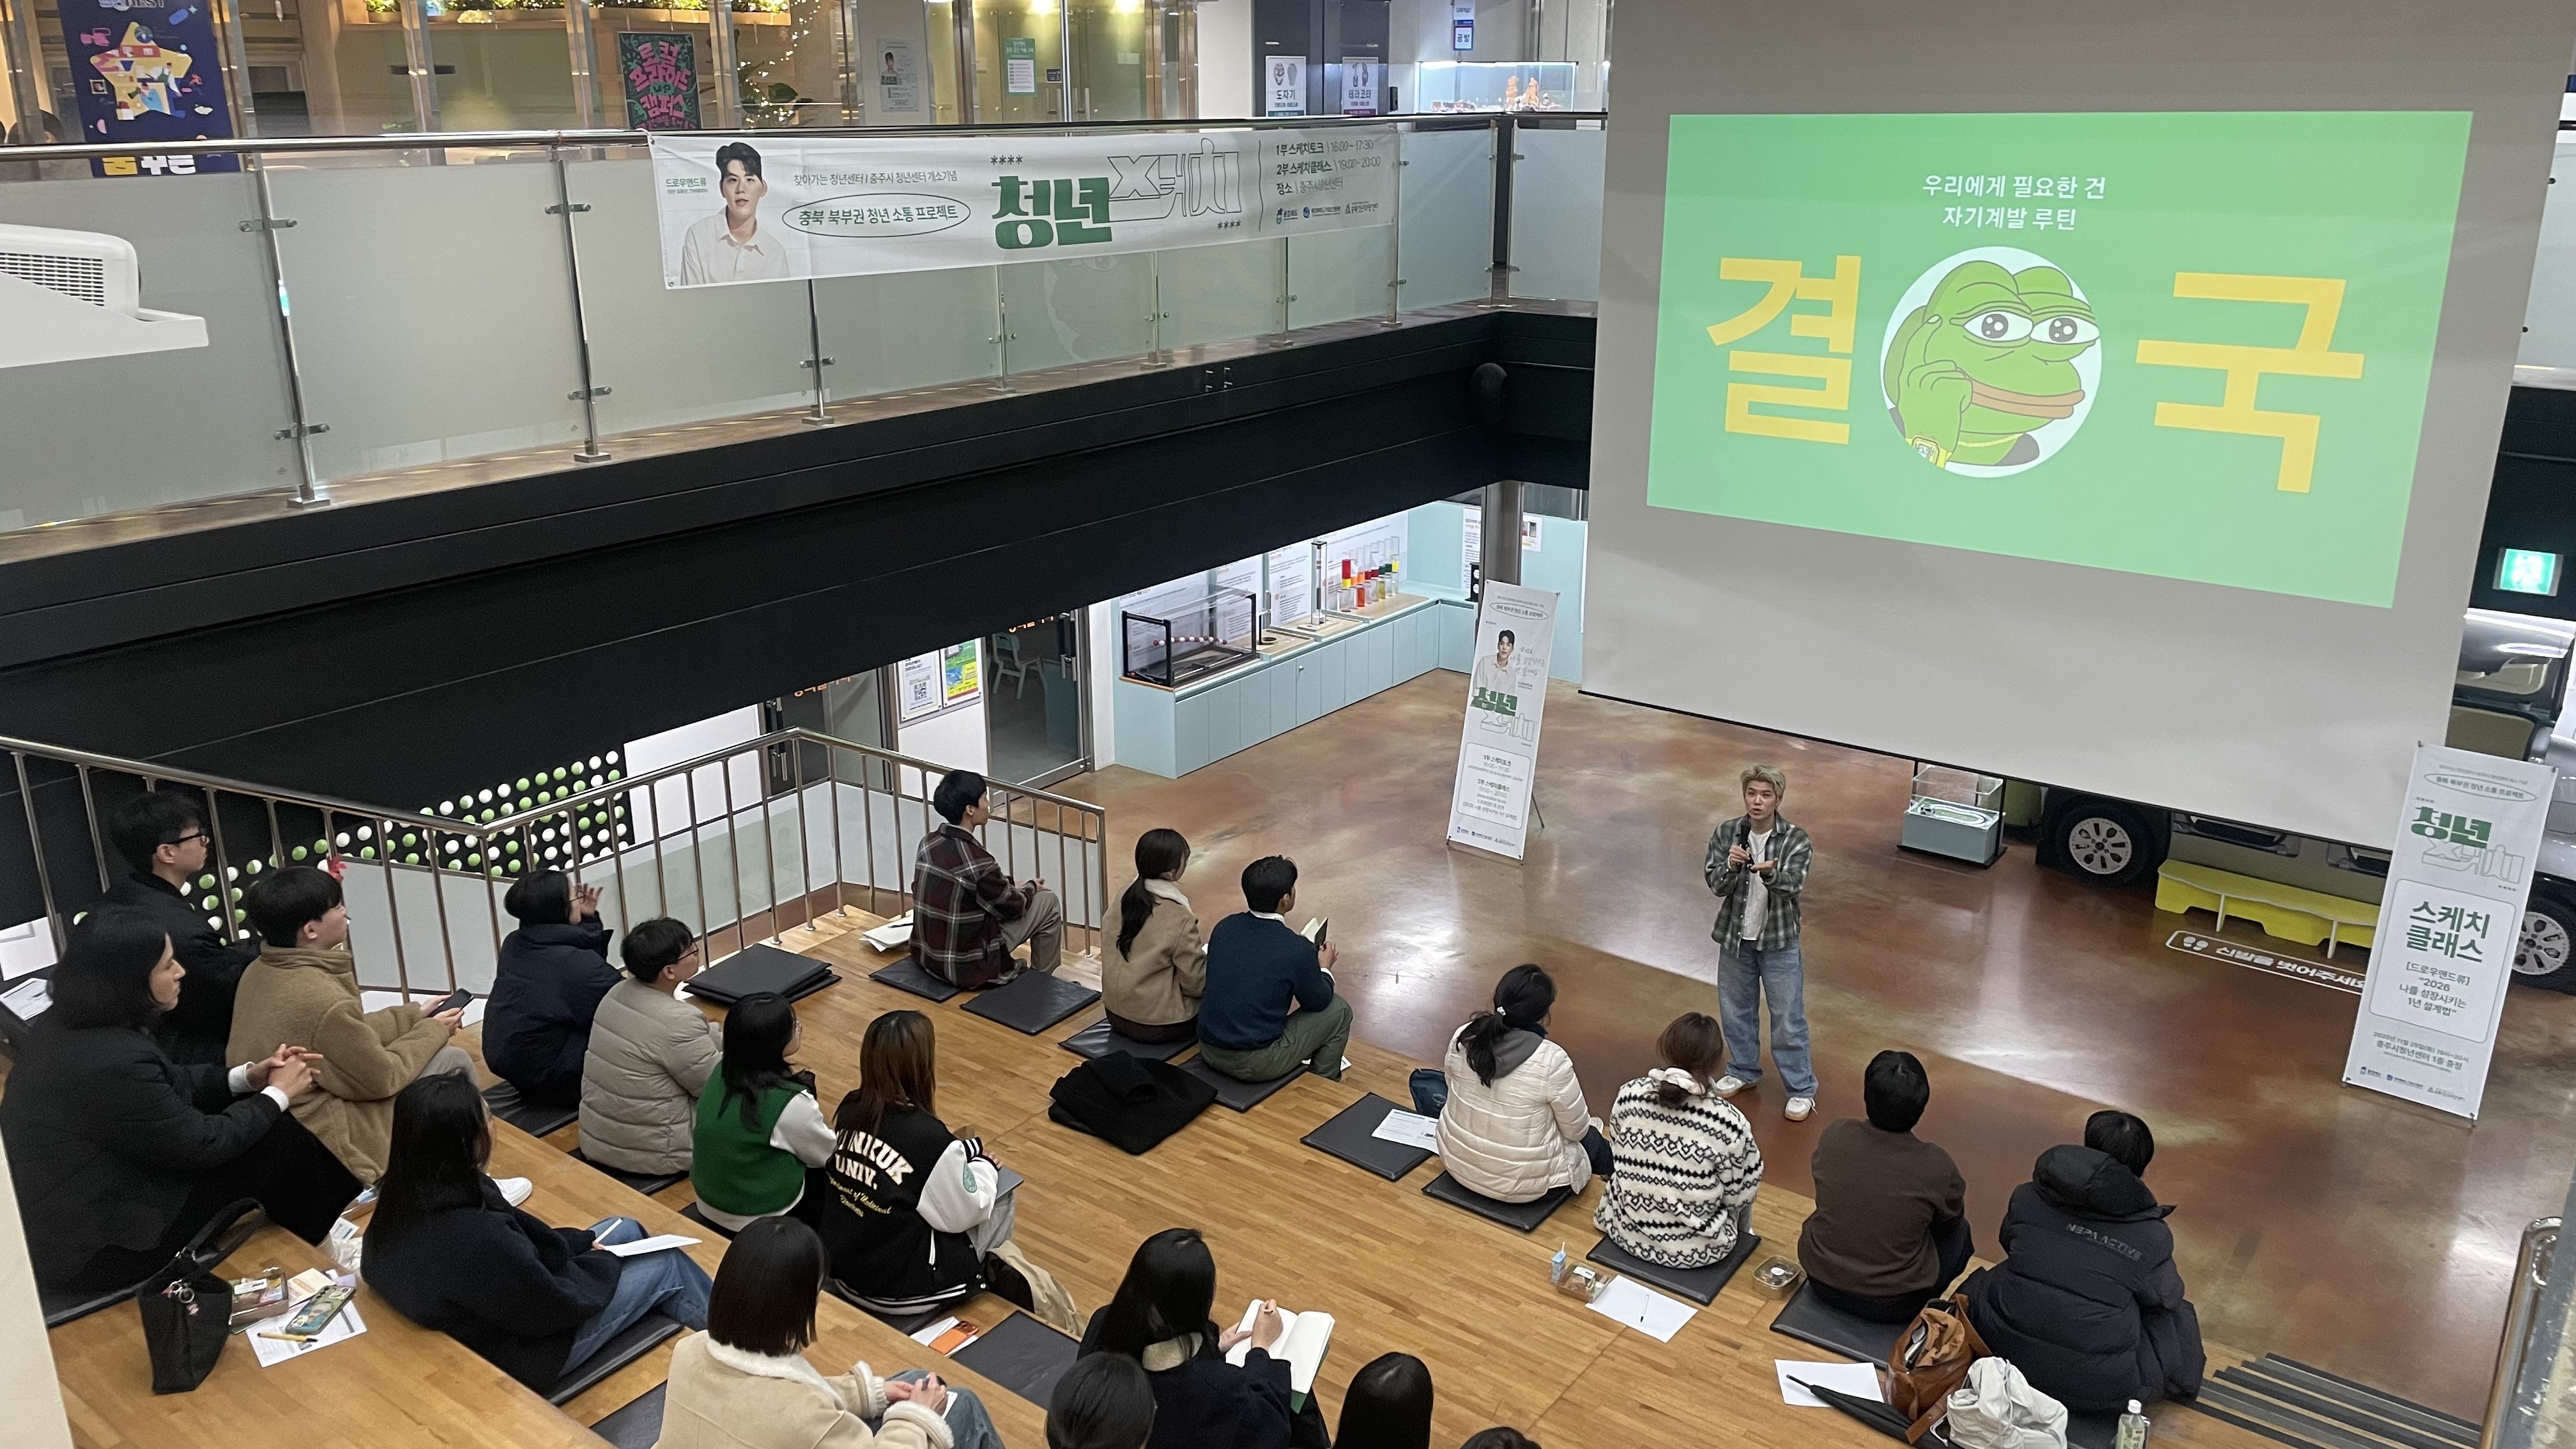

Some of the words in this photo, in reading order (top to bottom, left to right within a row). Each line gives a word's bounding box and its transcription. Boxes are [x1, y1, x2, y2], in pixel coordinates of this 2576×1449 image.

[1457, 34, 1470, 42] 공방
[640, 94, 685, 118] 캠퍼스
[1276, 89, 1296, 100] 도자기
[1348, 89, 1372, 99] 테라코타
[666, 177, 707, 187] 드로우앤드류
[793, 174, 828, 187] 찾아가는
[829, 172, 863, 185] 청년센터
[869, 172, 894, 184] 충주시
[895, 171, 926, 183] 청년센터
[928, 170, 958, 183] 개소기념
[1276, 182, 1294, 195] 장소
[1922, 174, 2006, 199] 우리에게
[2012, 176, 2079, 200] 필요한
[2084, 176, 2106, 201] 건
[799, 210, 824, 226] 충북
[827, 209, 864, 225] 북부권
[866, 208, 891, 224] 청년
[892, 206, 914, 222] 소통
[915, 204, 958, 220] 프로젝트
[991, 176, 1113, 250] 청년
[1942, 206, 2027, 231] 자기계발
[2032, 207, 2076, 231] 루틴
[1707, 255, 1861, 445] 결
[2136, 272, 2365, 493] 국
[1470, 687, 1517, 716] 청년
[2411, 806, 2492, 849] 청년
[2410, 901, 2490, 939] 스케치
[2406, 924, 2483, 963] 클래스
[2216, 946, 2274, 967] 신발을
[2399, 983, 2418, 995] 나를
[2420, 989, 2467, 1009] 성장시키는
[2407, 997, 2422, 1008] 1년
[836, 1128, 914, 1186] NKUK
[834, 1153, 878, 1191] UNIV.
[2066, 1223, 2098, 1240] NEPA
[2099, 1236, 2142, 1261] ACTIVE
